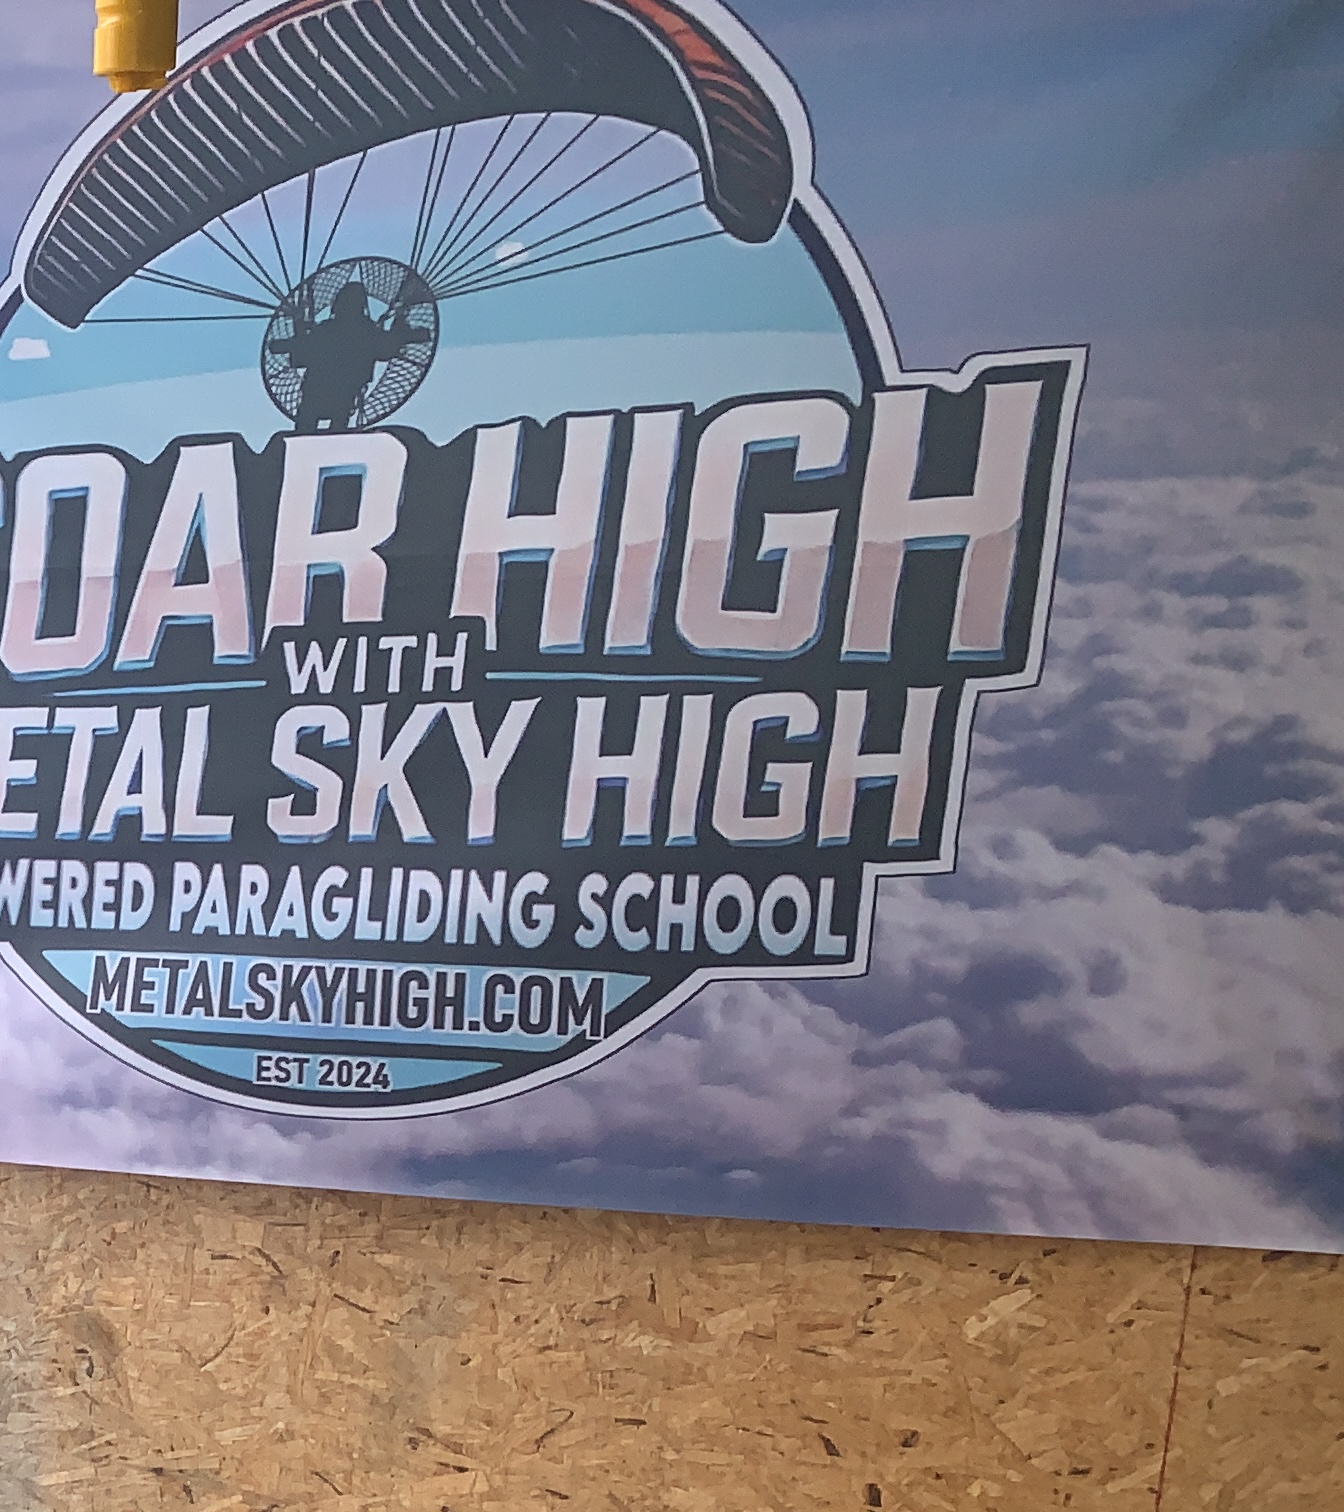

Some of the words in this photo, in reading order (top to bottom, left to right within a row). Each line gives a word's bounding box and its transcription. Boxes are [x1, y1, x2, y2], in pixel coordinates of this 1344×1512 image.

[450, 380, 1044, 663] HIGH
[283, 632, 469, 695] WITH
[266, 697, 542, 845] SKY
[561, 686, 943, 848] HIGH
[169, 862, 556, 949] PARAGLIDING
[574, 871, 848, 956] SCHOOL
[89, 955, 605, 1037] METALSKYHIGH.COM
[255, 1055, 309, 1084] EST
[318, 1059, 391, 1089] 2024
